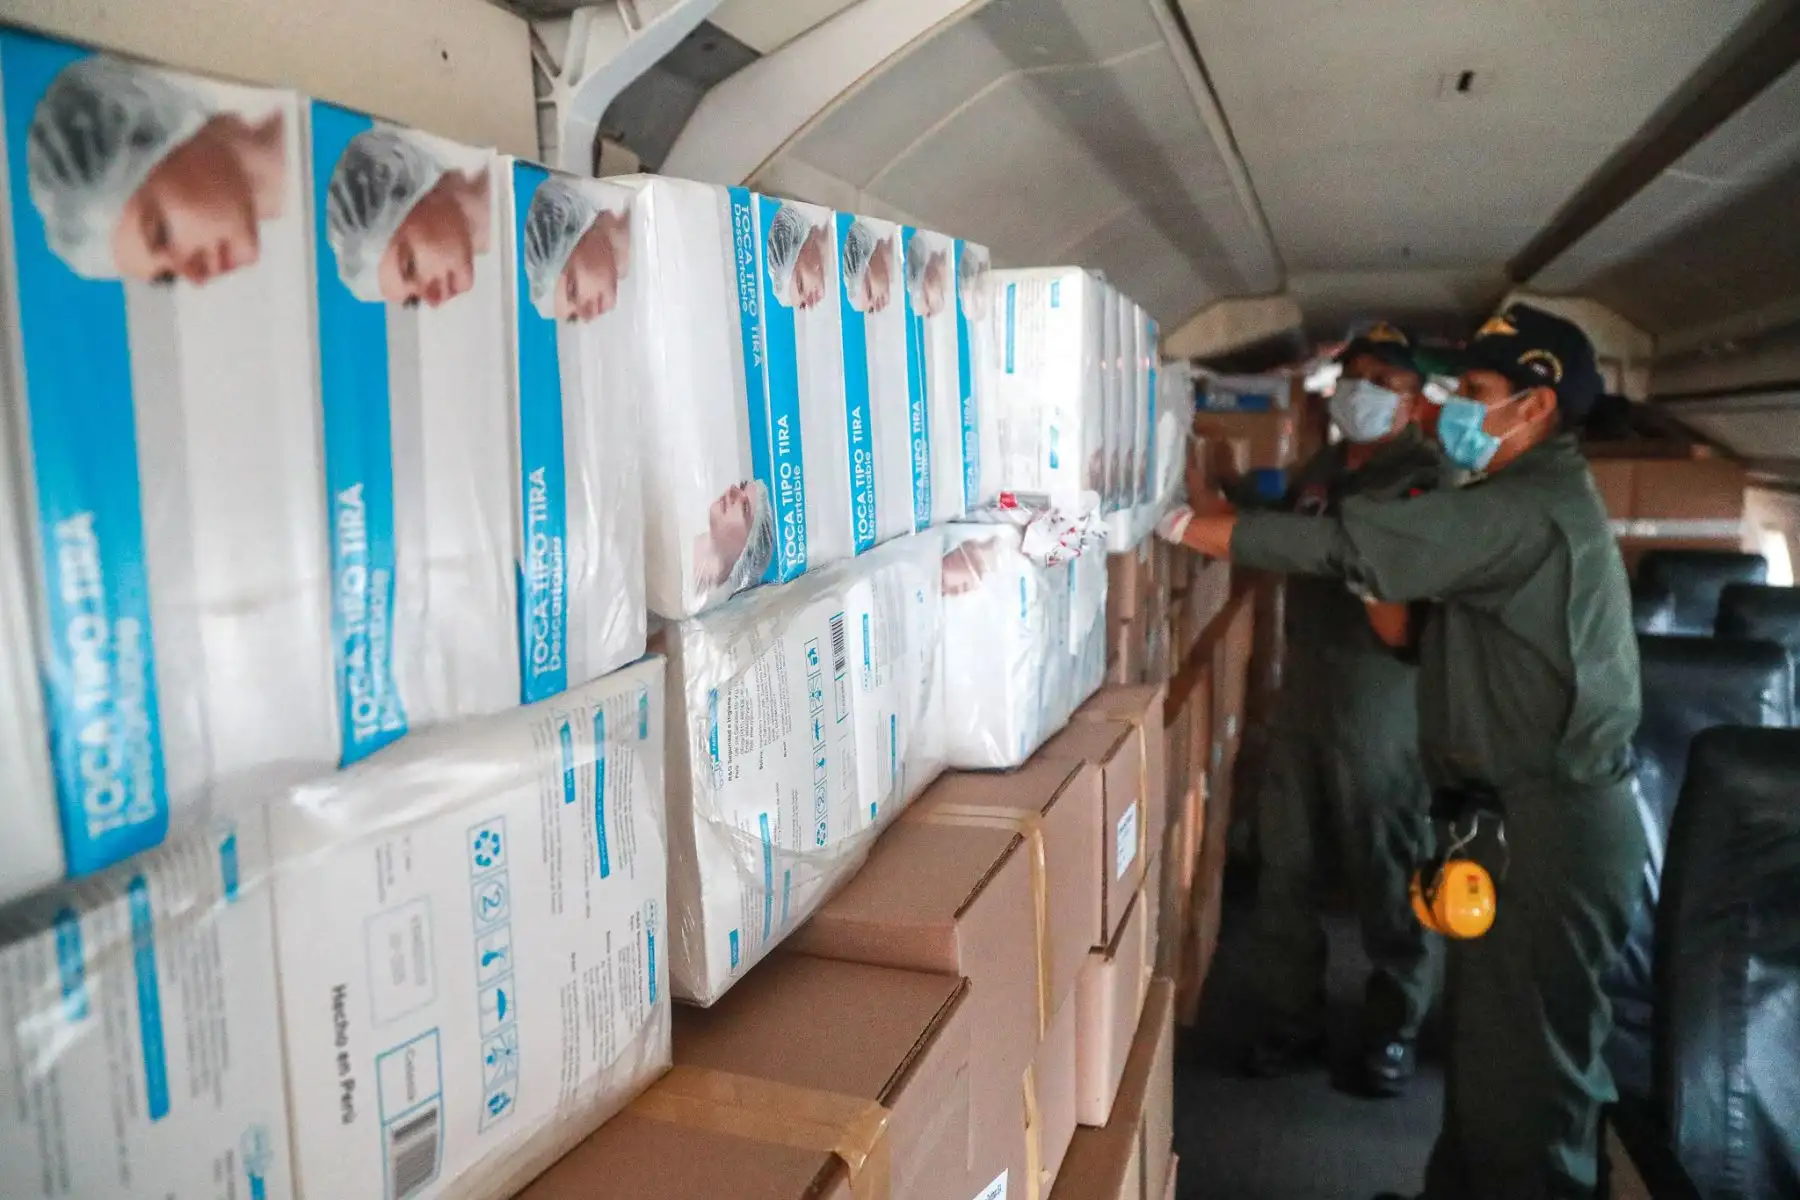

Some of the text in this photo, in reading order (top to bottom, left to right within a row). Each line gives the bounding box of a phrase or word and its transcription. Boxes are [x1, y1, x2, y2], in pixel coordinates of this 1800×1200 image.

[734, 203, 748, 313] Descartable
[742, 205, 762, 368] TOCA TIPO TIRA
[911, 400, 922, 434] TIRA
[914, 439, 924, 474] TIPO
[337, 483, 367, 555] TIRA
[777, 413, 797, 568] TOCA TIPO TIRA
[793, 465, 805, 564] Descartable
[851, 405, 868, 543] TOCA TIPO TIRA
[864, 451, 875, 540] Descartable
[528, 466, 550, 679] TOCA TIPO TIRA
[332, 983, 349, 1048] Hecho
[336, 1051, 351, 1077] en
